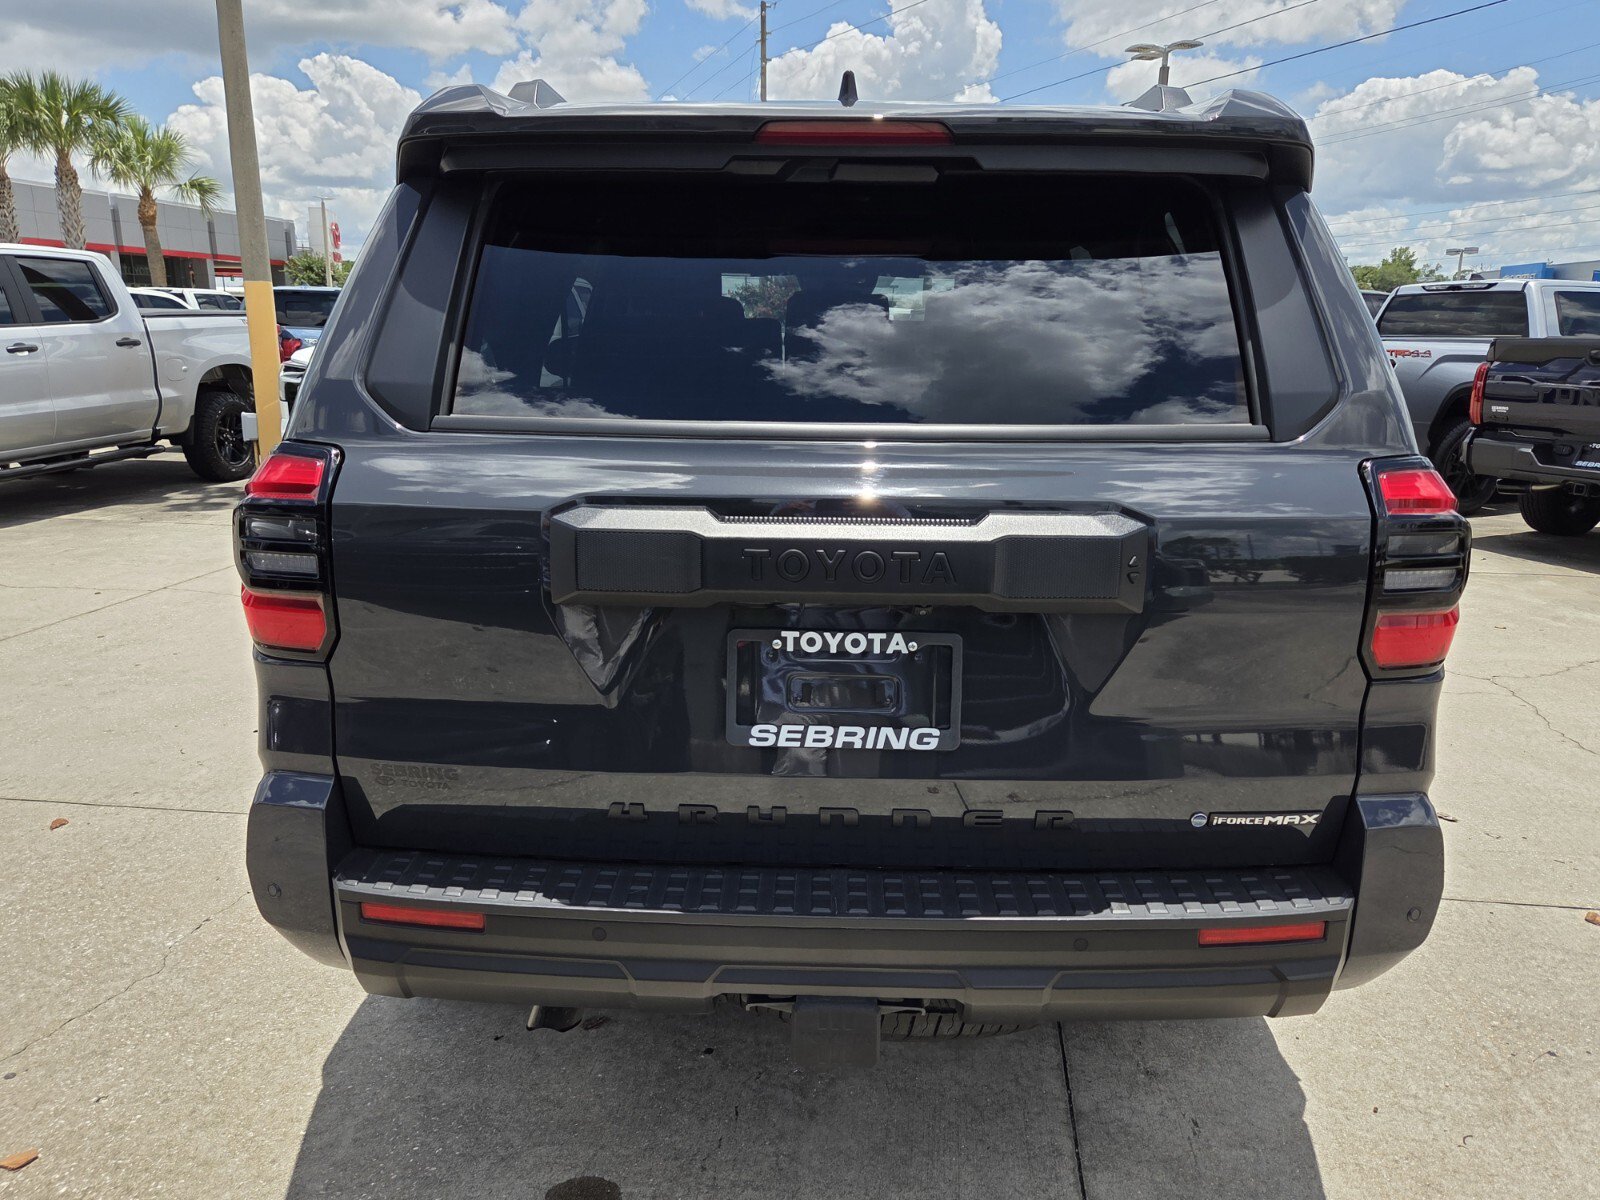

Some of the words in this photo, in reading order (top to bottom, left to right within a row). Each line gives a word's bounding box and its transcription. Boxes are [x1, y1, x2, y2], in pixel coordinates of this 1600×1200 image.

[742, 548, 958, 584] TOYOTA
[780, 630, 909, 654] TOYOTA
[748, 724, 941, 751] SEBRING
[370, 763, 459, 781] SEBRING
